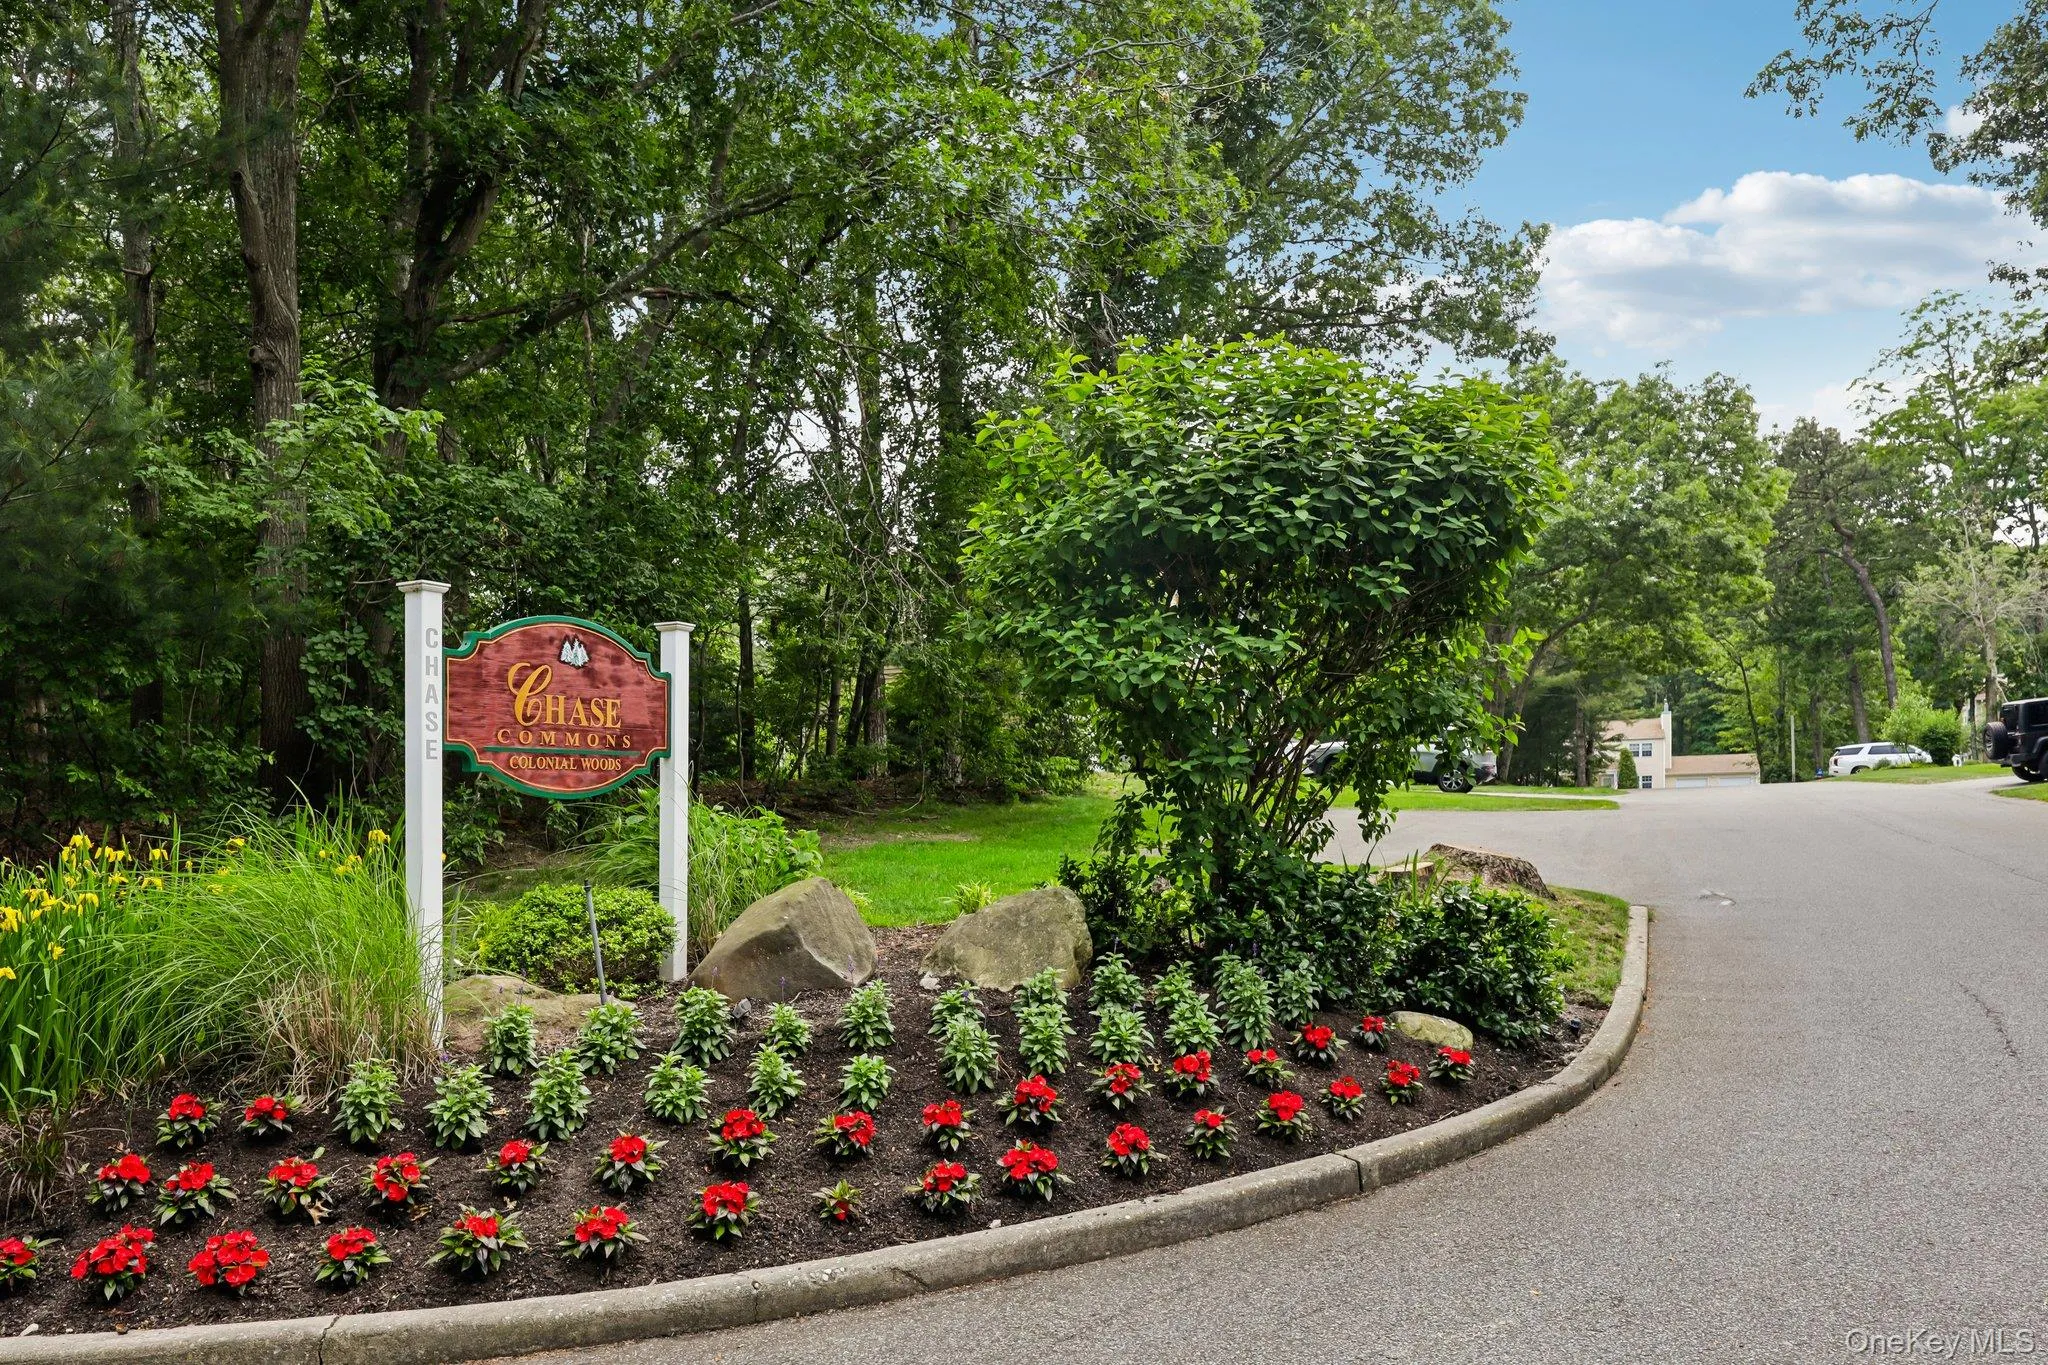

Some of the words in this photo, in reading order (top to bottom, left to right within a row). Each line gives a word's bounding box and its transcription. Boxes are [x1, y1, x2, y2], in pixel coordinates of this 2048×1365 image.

[425, 627, 439, 760] CHASE
[507, 662, 622, 728] CHASE
[497, 729, 631, 749] COMMONS
[510, 755, 577, 770] COLONIAL
[581, 757, 622, 771] WOODS
